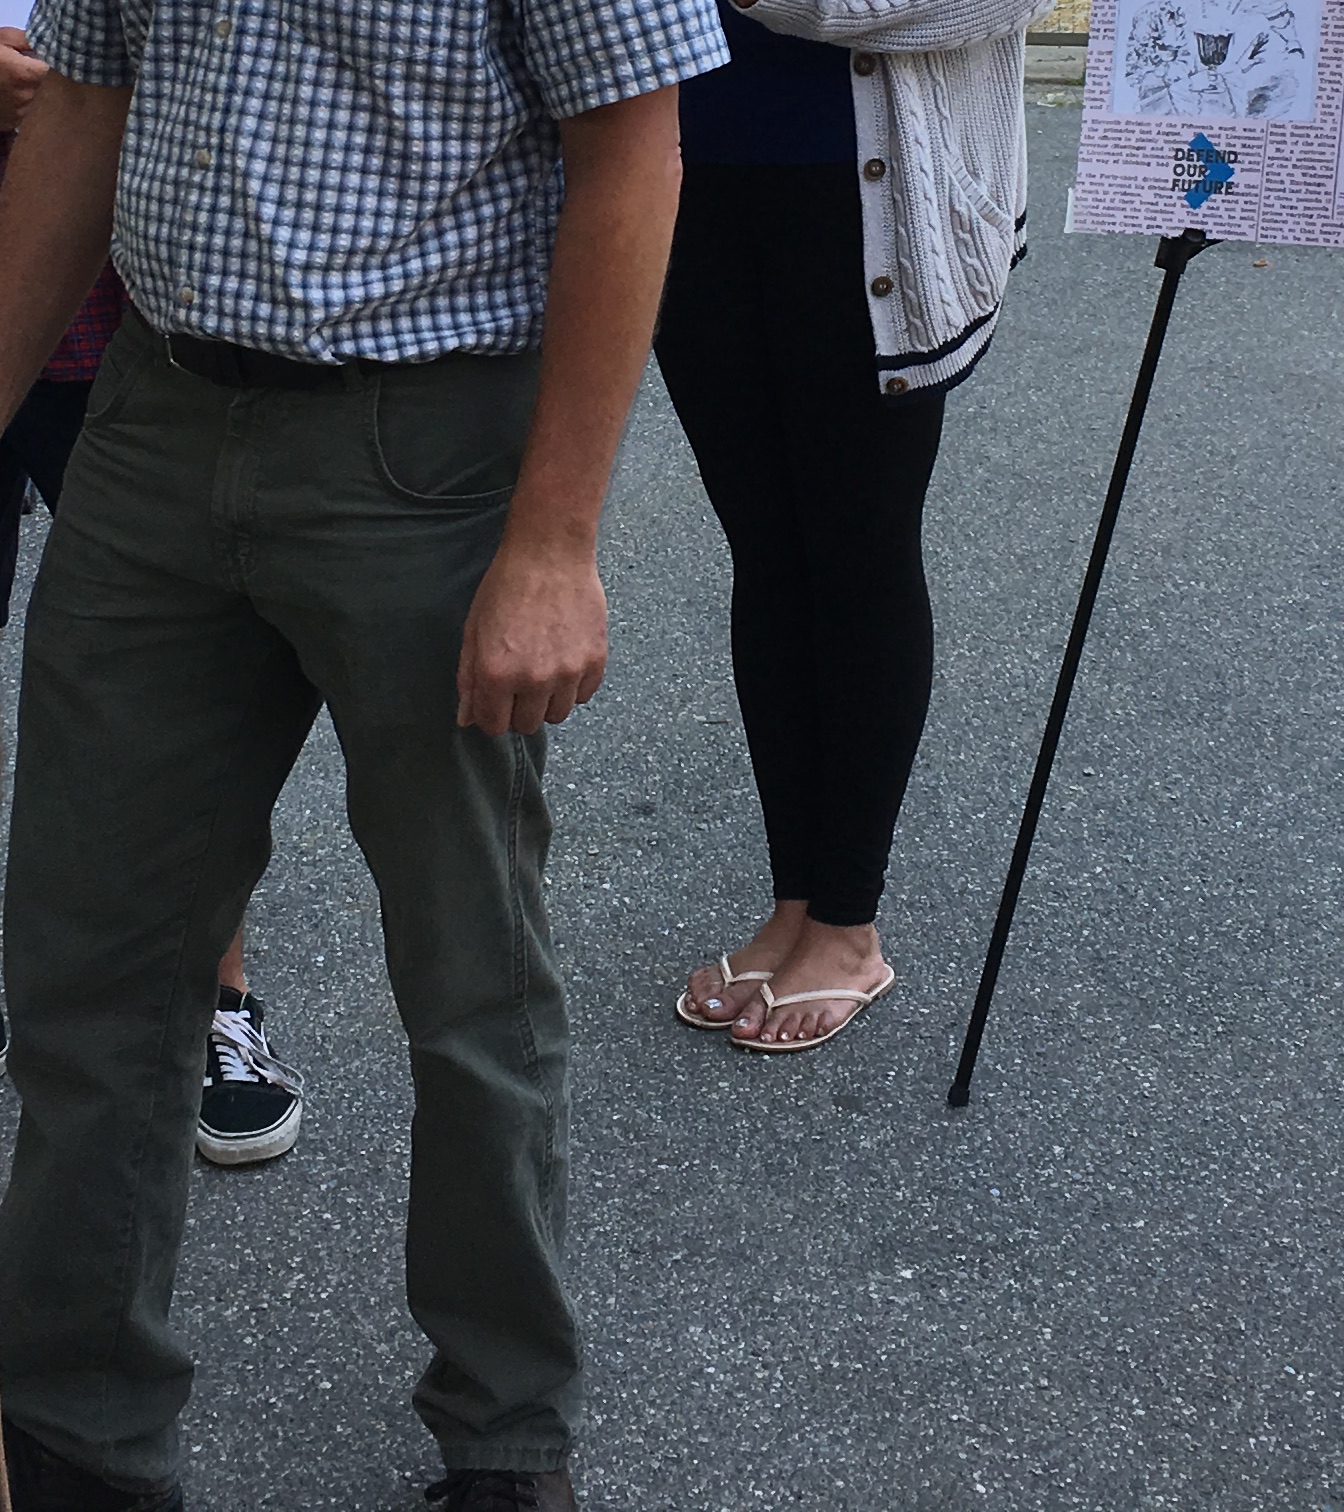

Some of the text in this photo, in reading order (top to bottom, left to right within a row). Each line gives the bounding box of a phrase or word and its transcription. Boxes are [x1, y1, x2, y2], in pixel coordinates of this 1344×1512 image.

[1174, 148, 1239, 164] DEFEND
[1173, 163, 1208, 178] OUR
[1170, 178, 1235, 196] FUTURE
